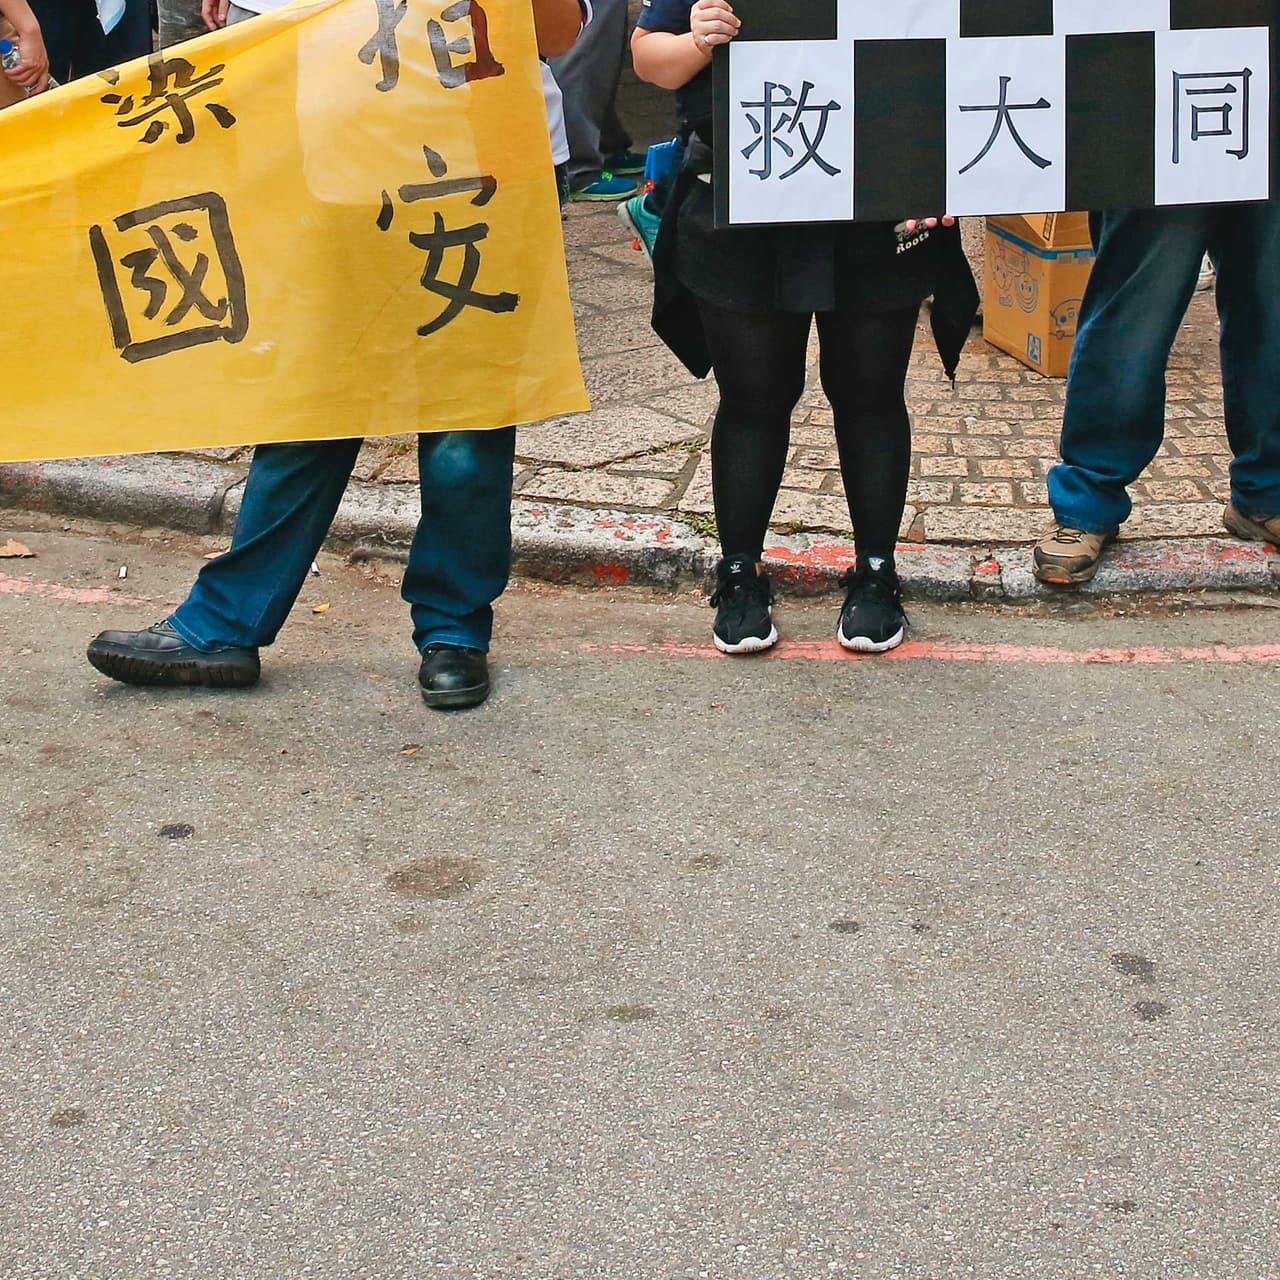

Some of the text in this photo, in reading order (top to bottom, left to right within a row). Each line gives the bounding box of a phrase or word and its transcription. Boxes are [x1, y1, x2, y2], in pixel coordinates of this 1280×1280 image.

[740, 68, 1252, 182] 救大同
[896, 230, 930, 255] Roots
